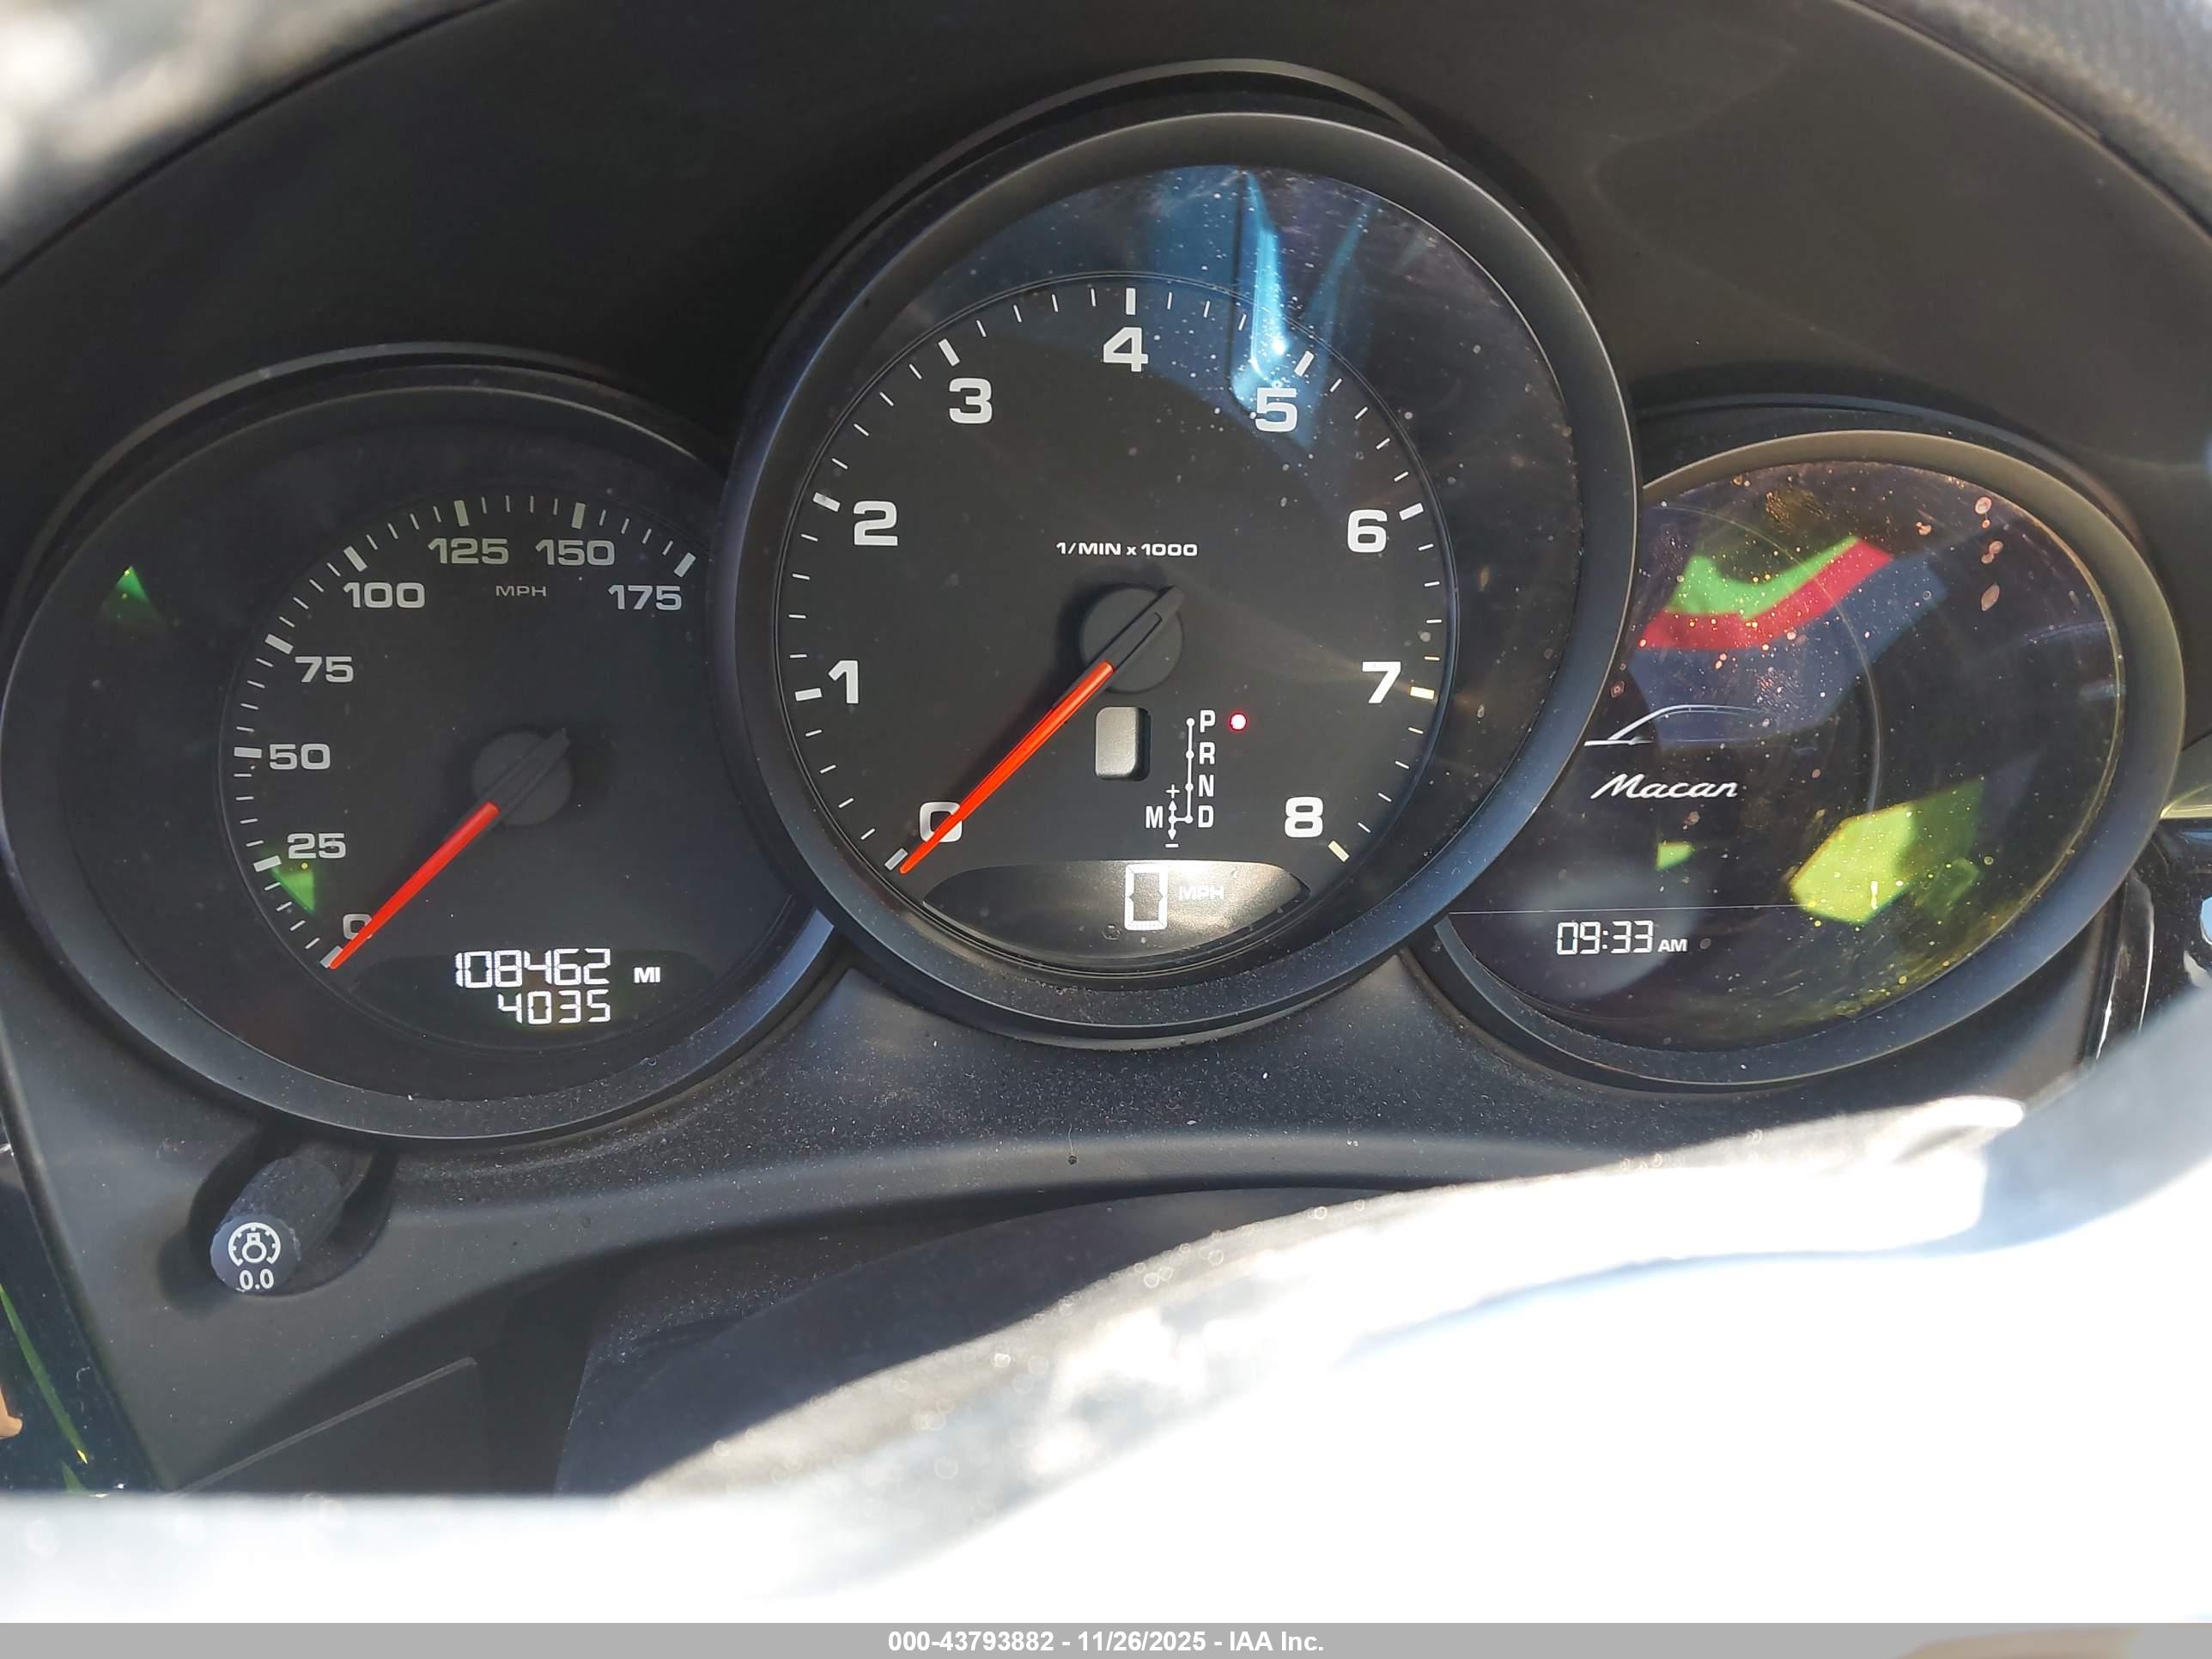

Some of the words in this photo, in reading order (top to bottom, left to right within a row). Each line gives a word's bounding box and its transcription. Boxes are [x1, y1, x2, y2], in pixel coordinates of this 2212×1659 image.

[1103, 327, 1148, 372] 4
[949, 378, 994, 423] 3
[1255, 387, 1297, 432] 5
[853, 501, 898, 546] 2
[1346, 509, 1387, 553] 6
[428, 538, 509, 565] 125
[536, 539, 616, 566] 150
[1056, 542, 1121, 556] 1/MIN
[1140, 542, 1198, 556] 1000
[343, 581, 425, 608] 100
[495, 586, 547, 597] MPH
[608, 585, 682, 611] 175
[295, 656, 355, 683] 75
[829, 660, 860, 704] 1
[1362, 661, 1402, 703] 7
[1199, 710, 1216, 732] P
[269, 744, 331, 770] 50
[1199, 742, 1215, 764] R
[1199, 775, 1214, 798] N
[1590, 774, 1738, 799] Macan
[919, 801, 963, 842] 0
[1146, 806, 1163, 829] M
[1199, 806, 1214, 828] D
[1284, 797, 1323, 837] 8
[287, 833, 346, 859] 25
[1124, 863, 1168, 930] 0
[1178, 886, 1224, 902] MPH
[1556, 920, 1654, 955] 09:33
[1657, 939, 1687, 952] AM
[455, 948, 611, 988] 108462
[634, 967, 660, 983] MI
[498, 989, 611, 1024] 4035
[239, 1268, 274, 1291] 0.0
